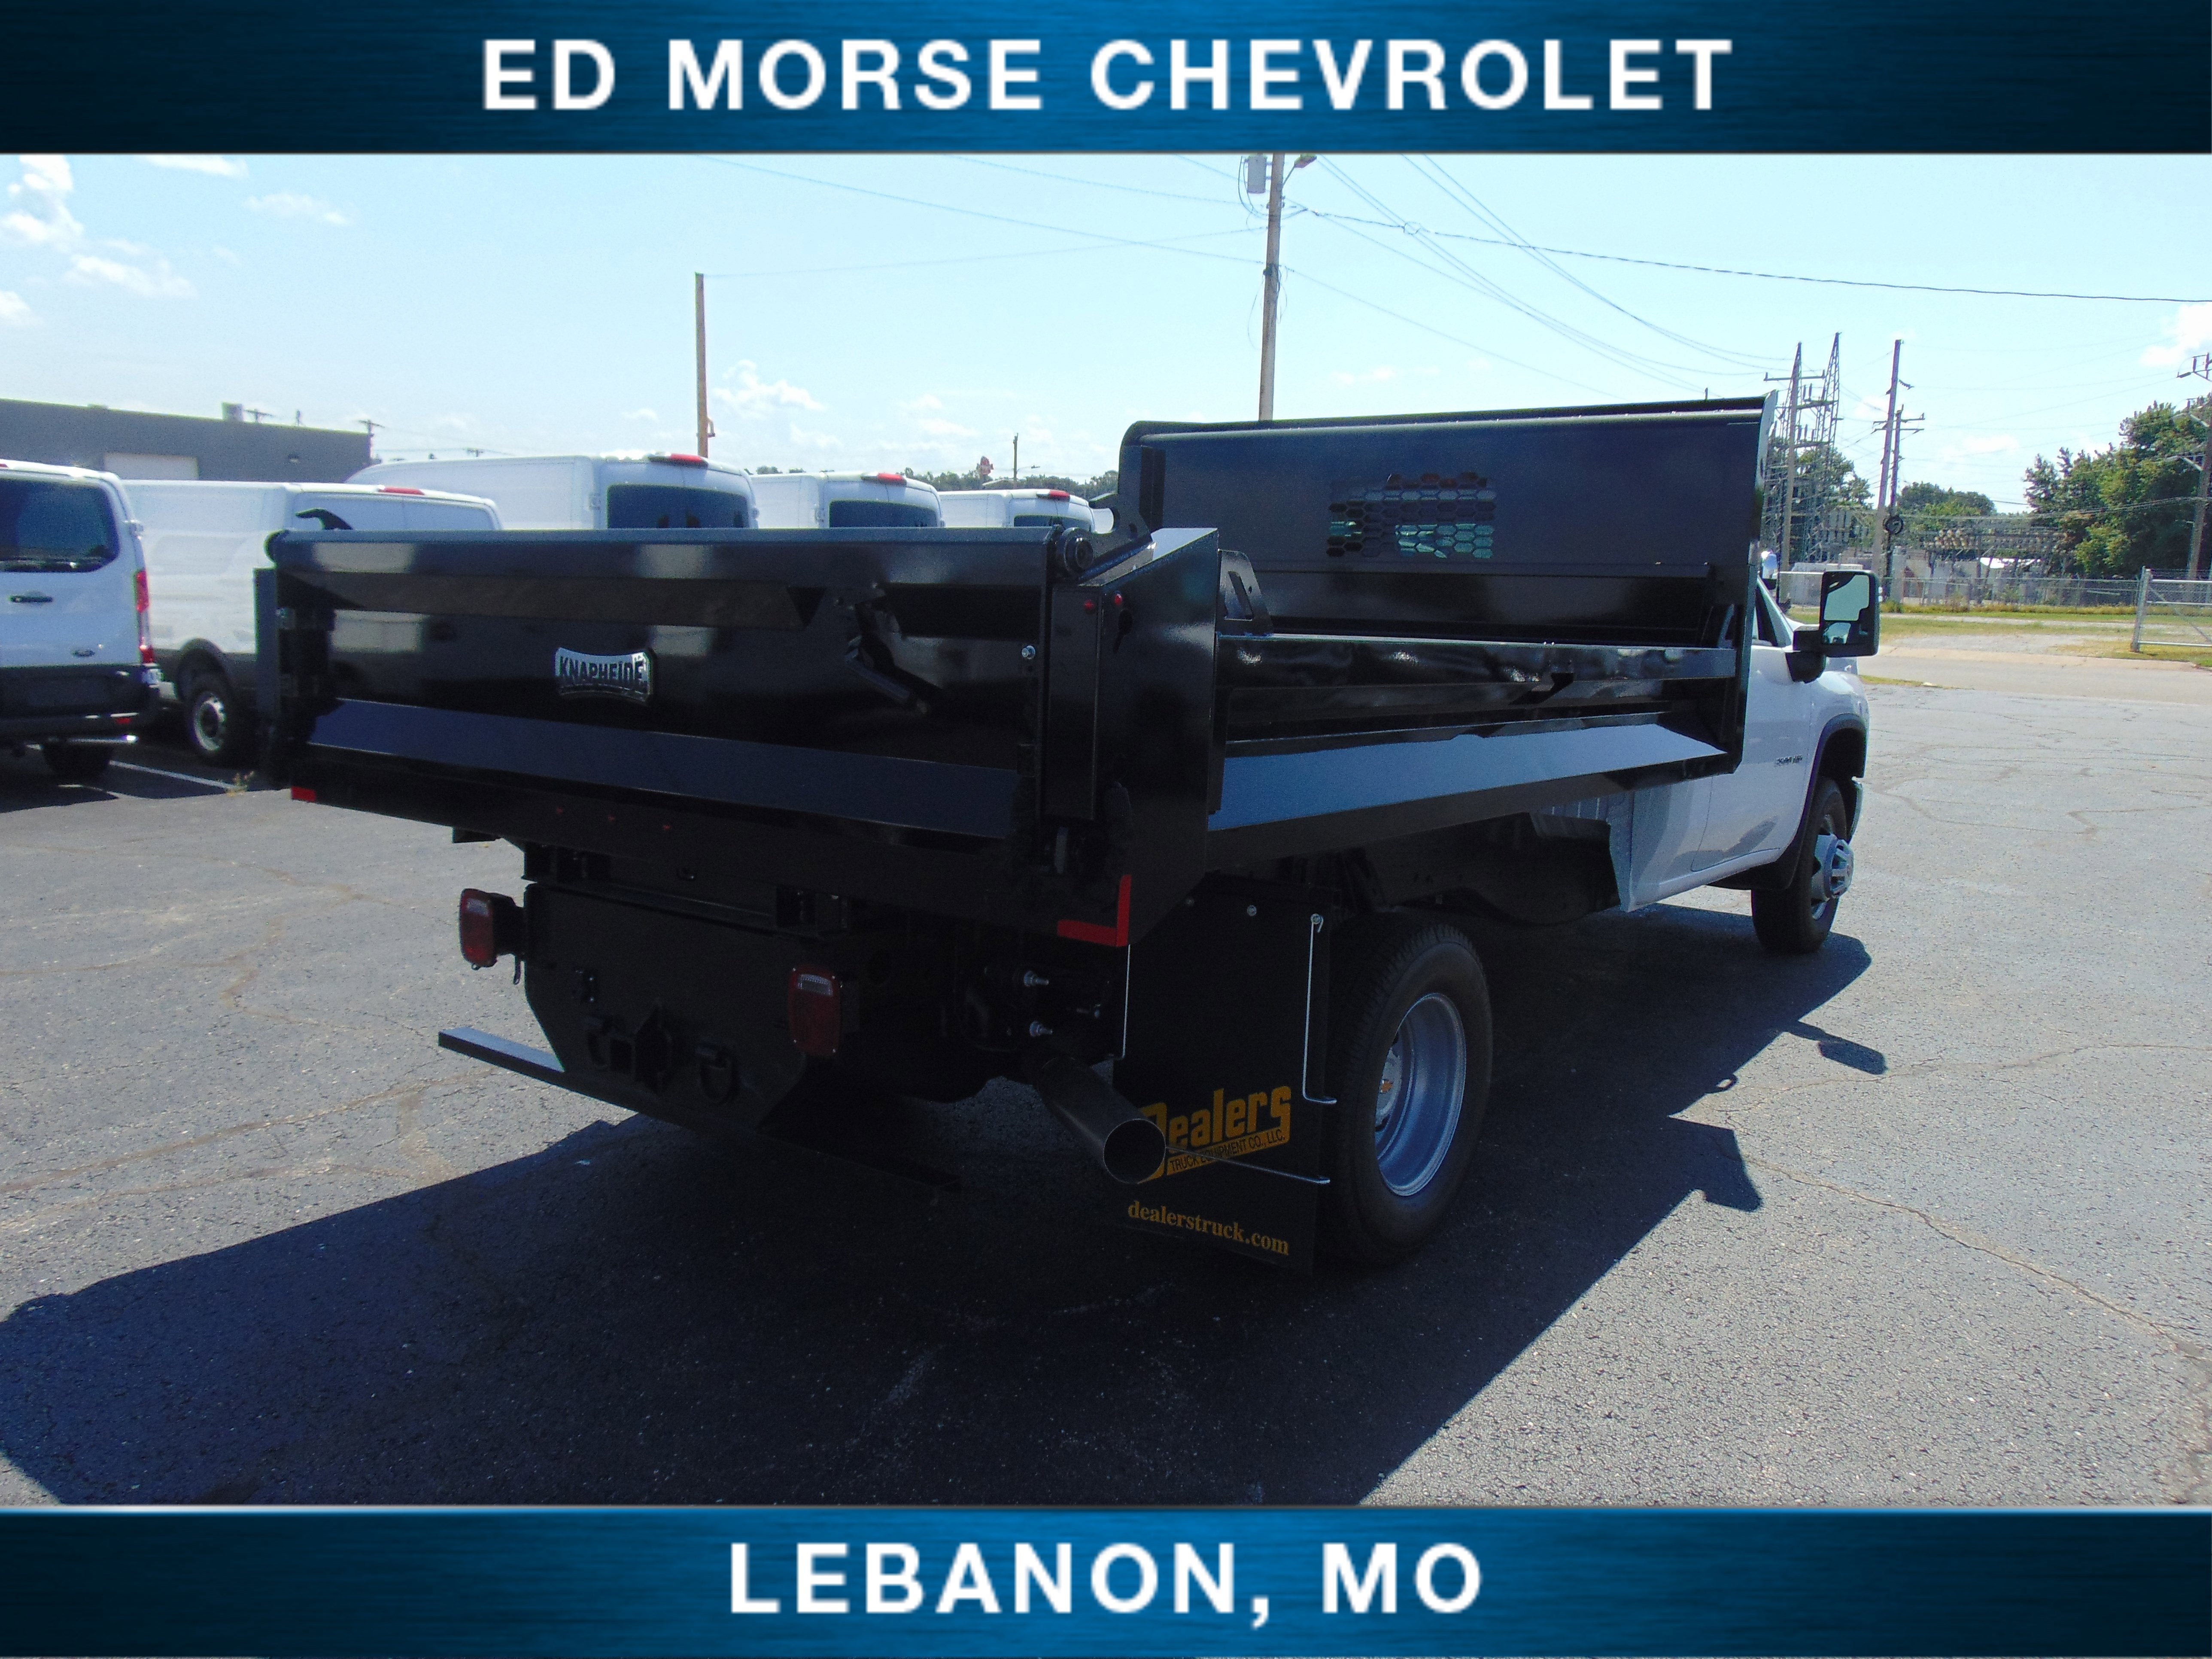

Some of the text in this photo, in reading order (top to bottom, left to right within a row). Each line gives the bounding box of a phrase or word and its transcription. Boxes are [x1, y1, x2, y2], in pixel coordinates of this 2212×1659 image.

[559, 655, 646, 693] KNAPHEIDE
[1170, 1155, 1201, 1171] TRUCK
[1127, 1200, 1289, 1256] dealerstruck.com
